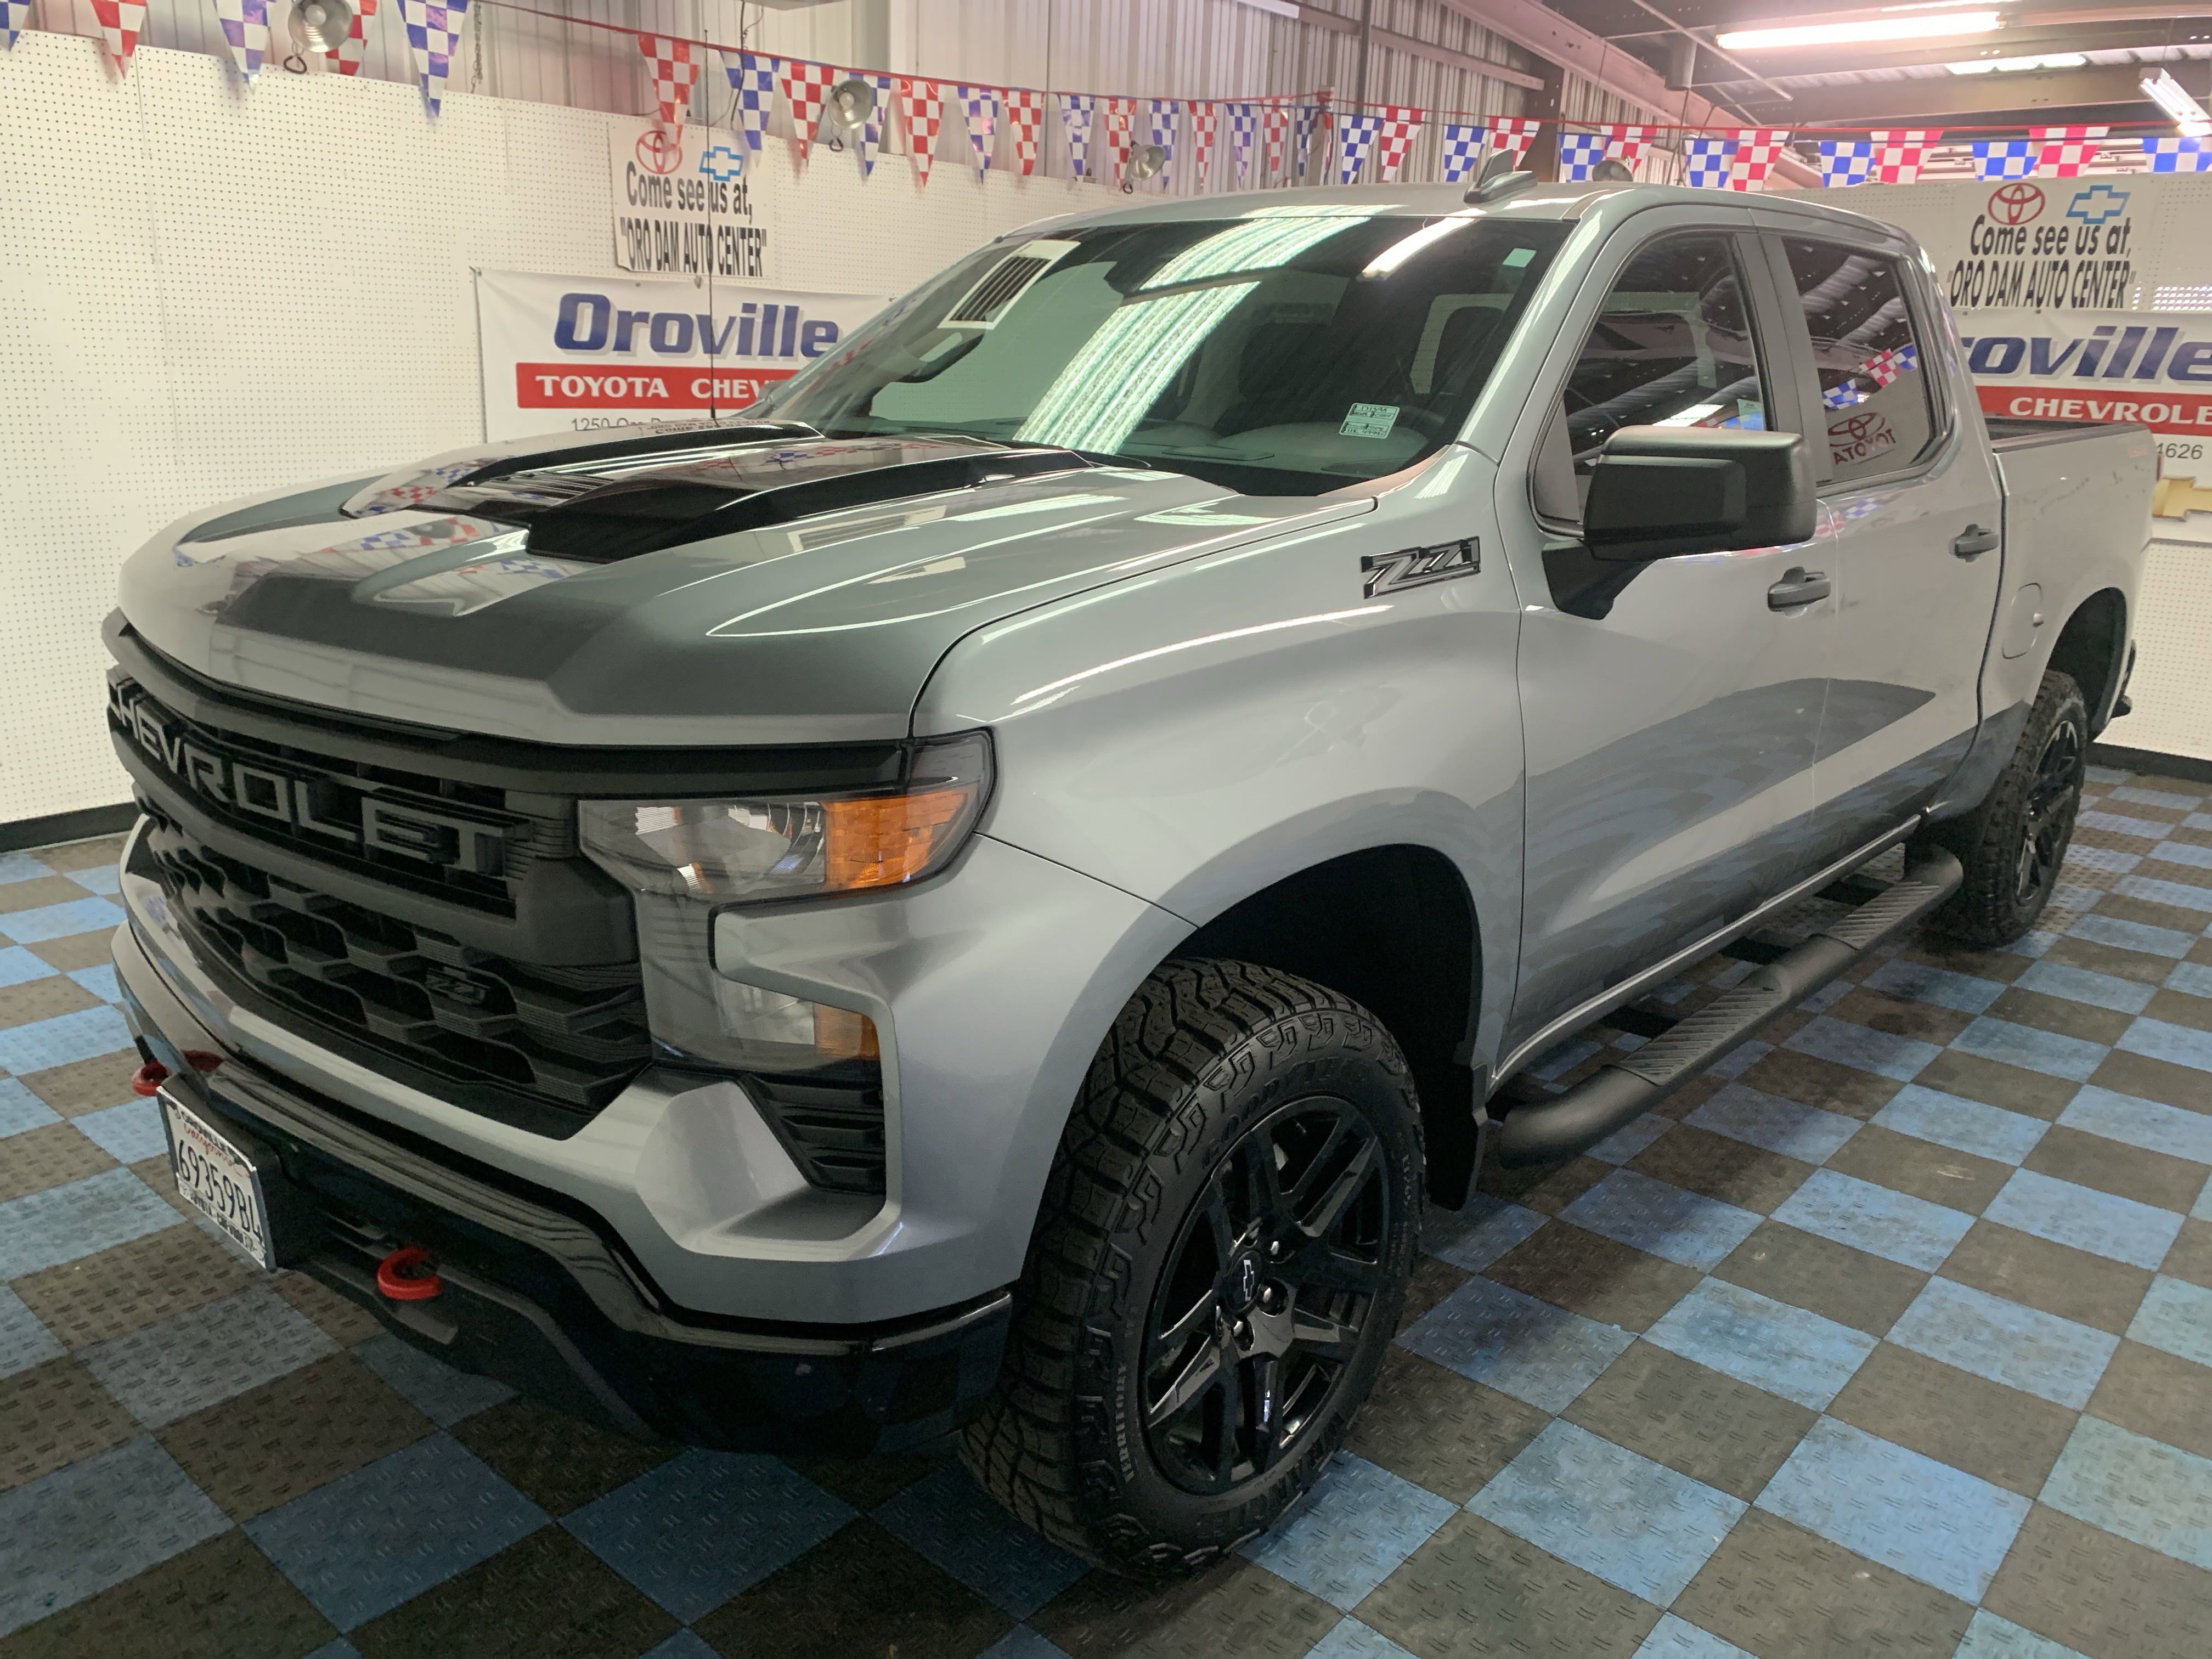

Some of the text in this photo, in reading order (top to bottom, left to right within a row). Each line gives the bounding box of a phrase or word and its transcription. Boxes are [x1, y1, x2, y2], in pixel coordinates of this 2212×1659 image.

[626, 160, 752, 226] Come see us at,
[619, 217, 767, 278] "ORO DAM AUTO CENTER"
[1971, 214, 2131, 258] Come see us at,
[1946, 259, 2137, 309] "ORO DAM AUTO CENTER"
[554, 292, 839, 357] Oroville
[535, 375, 669, 398] TOYOTA
